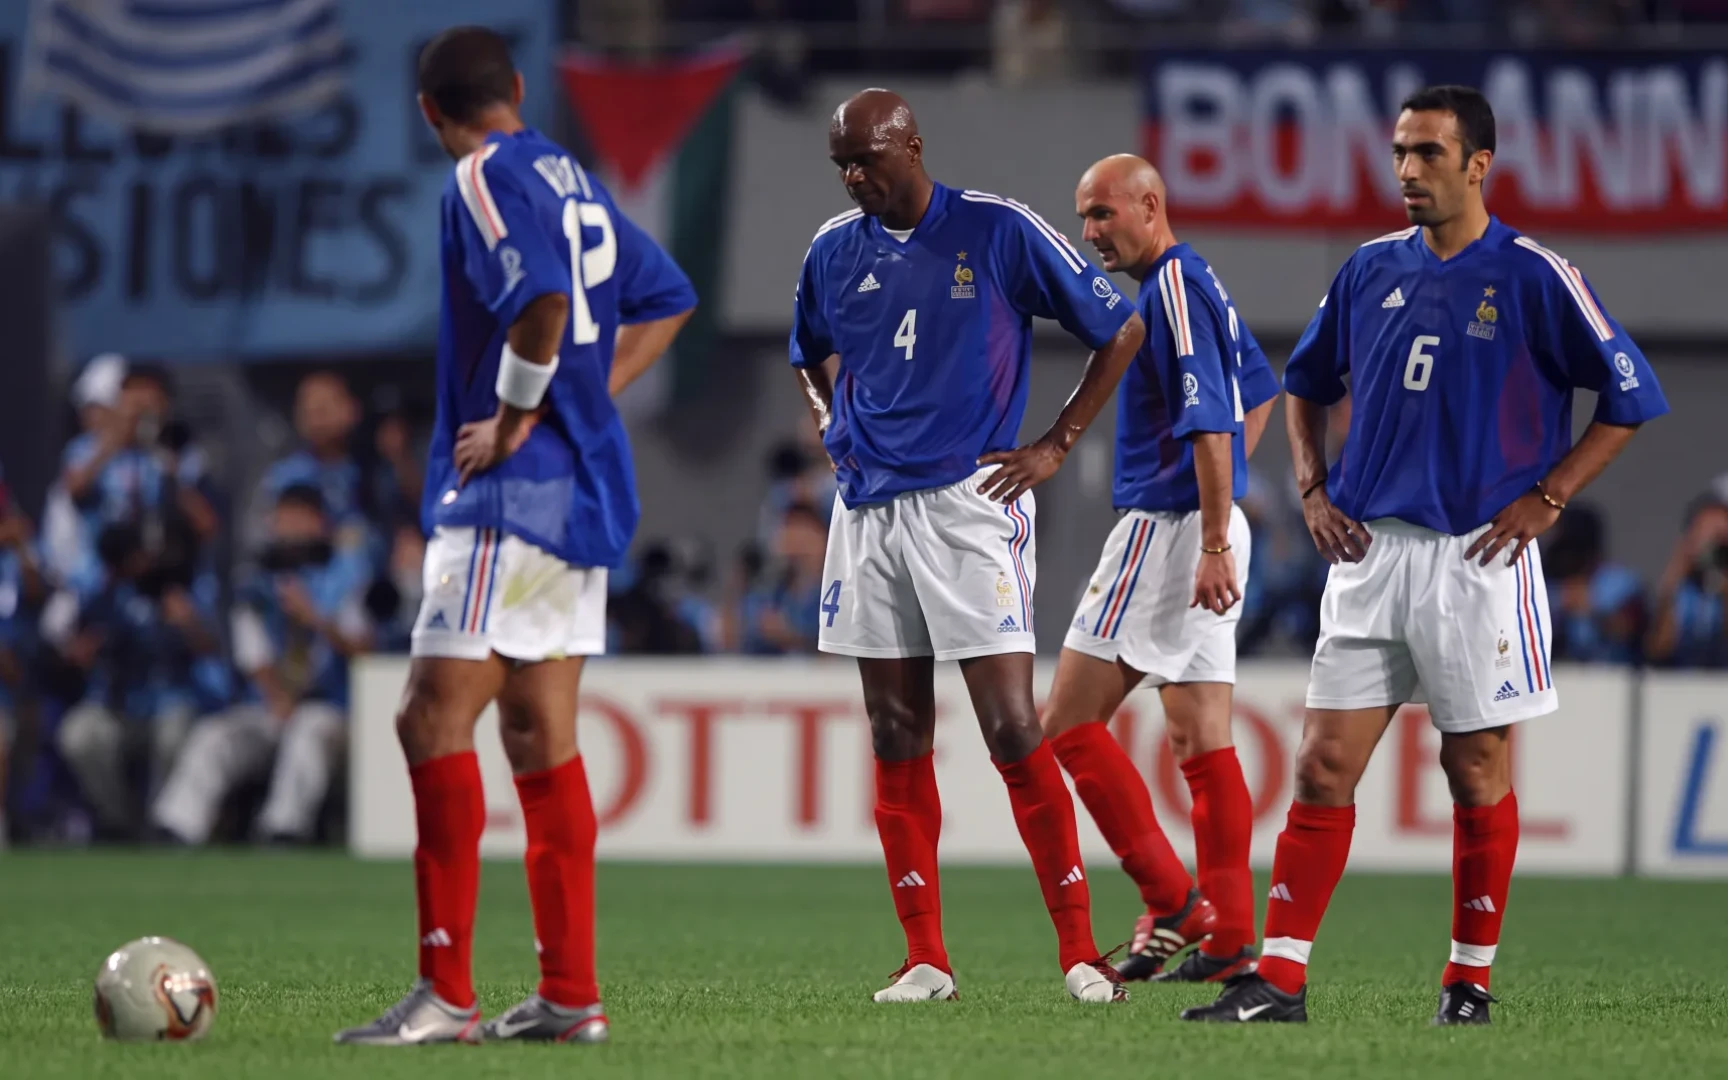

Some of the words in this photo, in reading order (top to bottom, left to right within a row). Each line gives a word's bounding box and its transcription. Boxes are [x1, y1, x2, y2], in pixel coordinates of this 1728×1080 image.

[1160, 63, 1424, 210] BON
[562, 198, 617, 345] 12
[894, 309, 916, 360] 4
[1403, 335, 1440, 391] 6
[822, 580, 842, 627] 4
